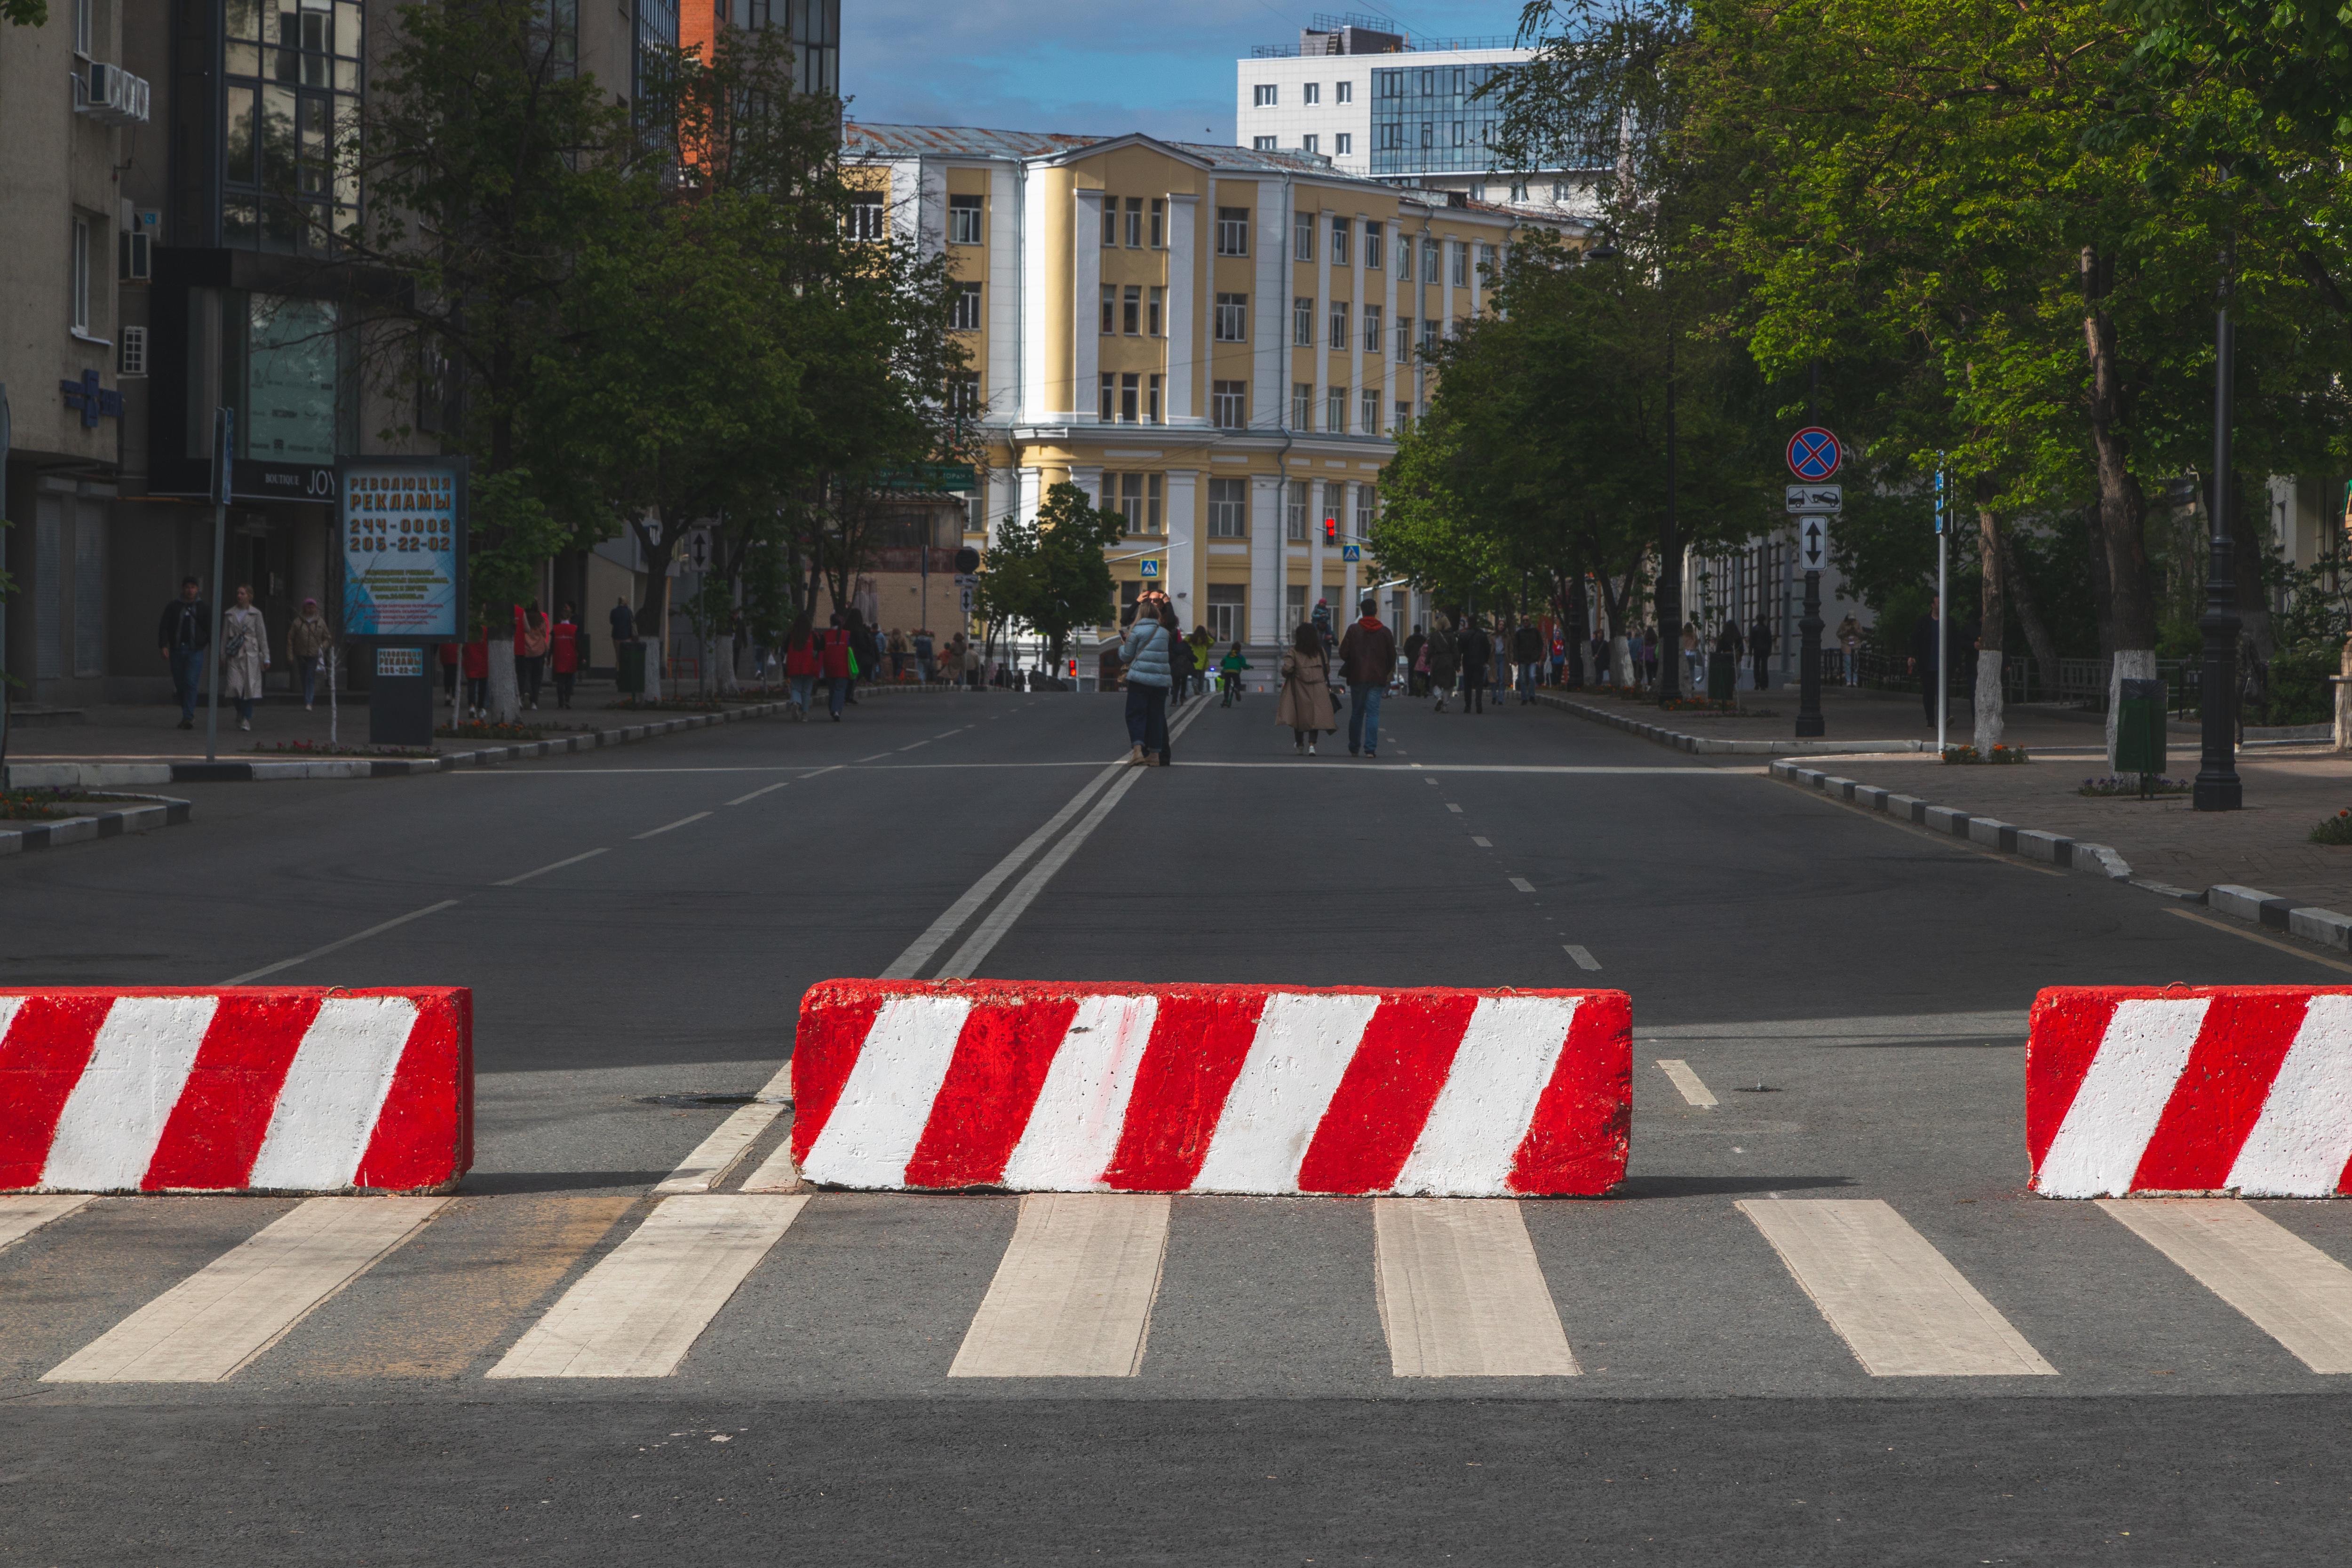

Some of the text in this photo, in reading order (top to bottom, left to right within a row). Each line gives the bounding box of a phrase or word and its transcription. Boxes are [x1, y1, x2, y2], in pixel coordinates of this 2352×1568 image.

[265, 473, 300, 486] BOUTIQUE
[350, 477, 450, 492] РЕВОЛЮЦИЯ
[350, 493, 450, 510] РЕКЛАМЫ
[350, 518, 450, 533] 244-0008
[350, 536, 450, 551] 205-22-02
